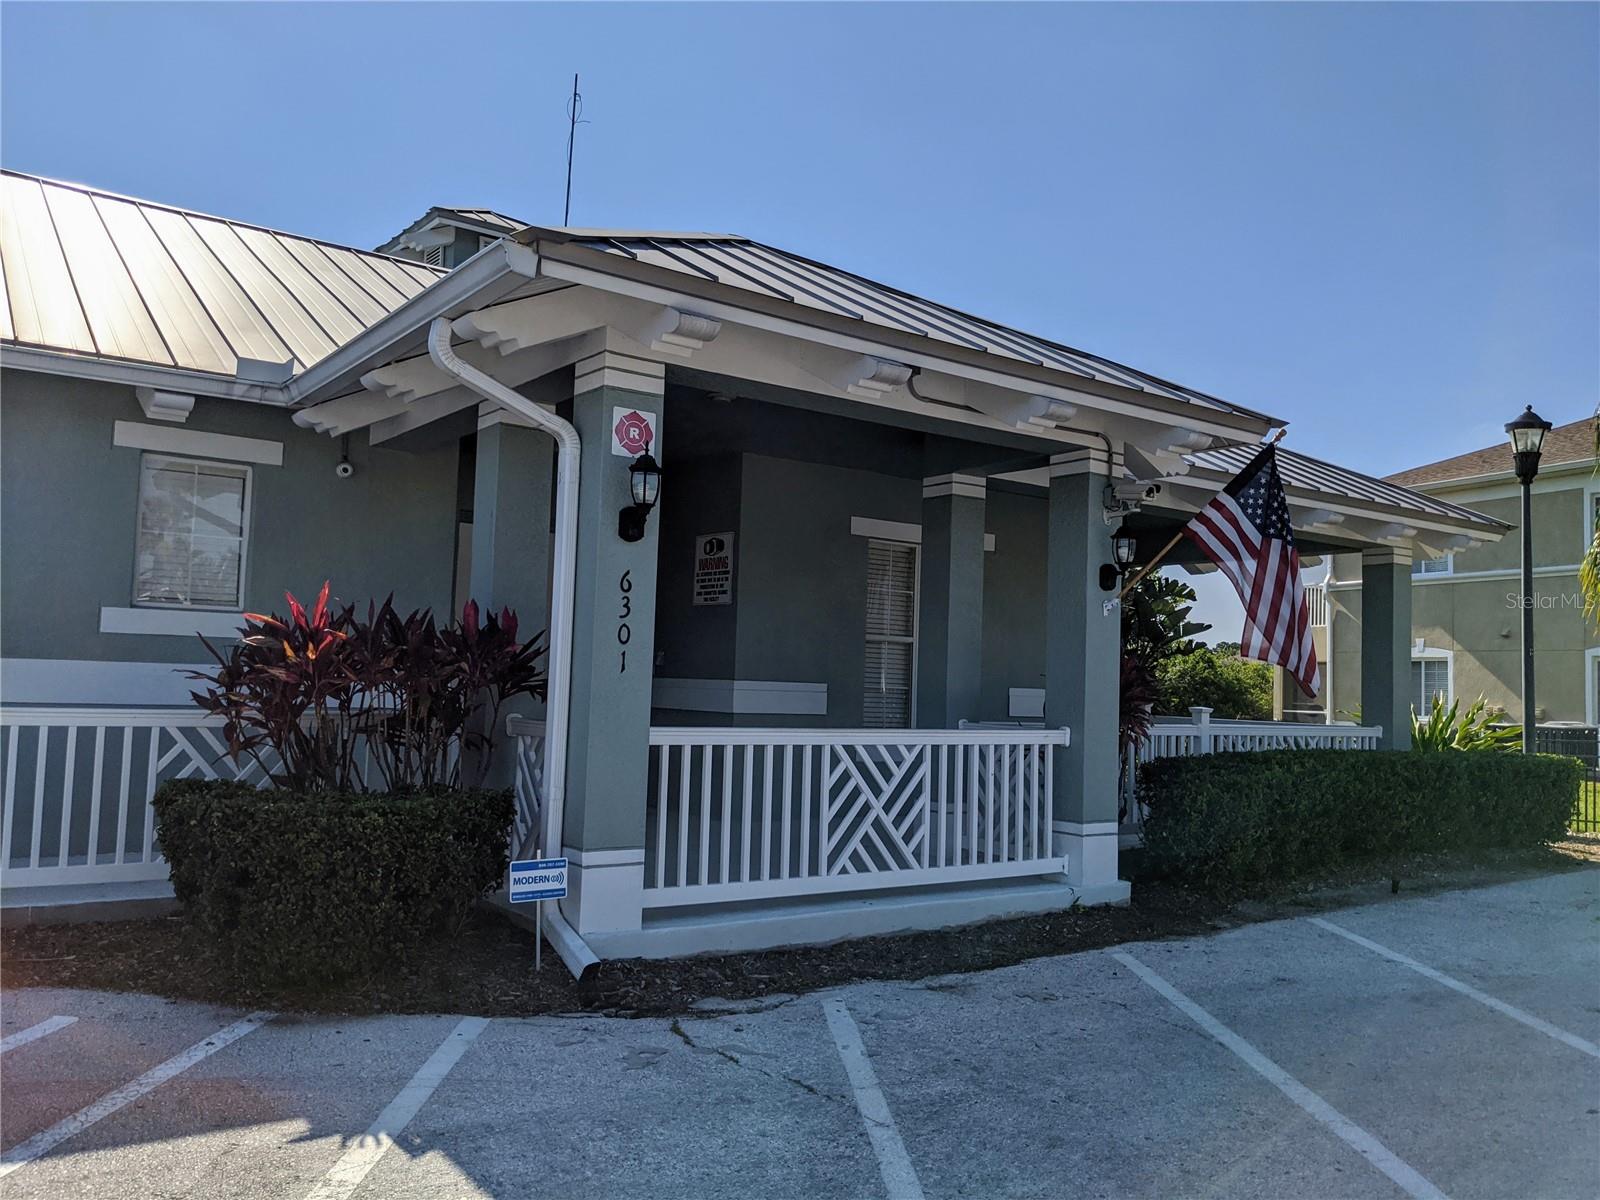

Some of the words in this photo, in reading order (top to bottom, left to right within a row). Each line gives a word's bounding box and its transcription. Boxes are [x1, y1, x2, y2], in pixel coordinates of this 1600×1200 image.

[629, 427, 640, 440] R
[698, 556, 729, 571] WARNING
[617, 569, 633, 674] 6301
[513, 875, 551, 886] MODERN
